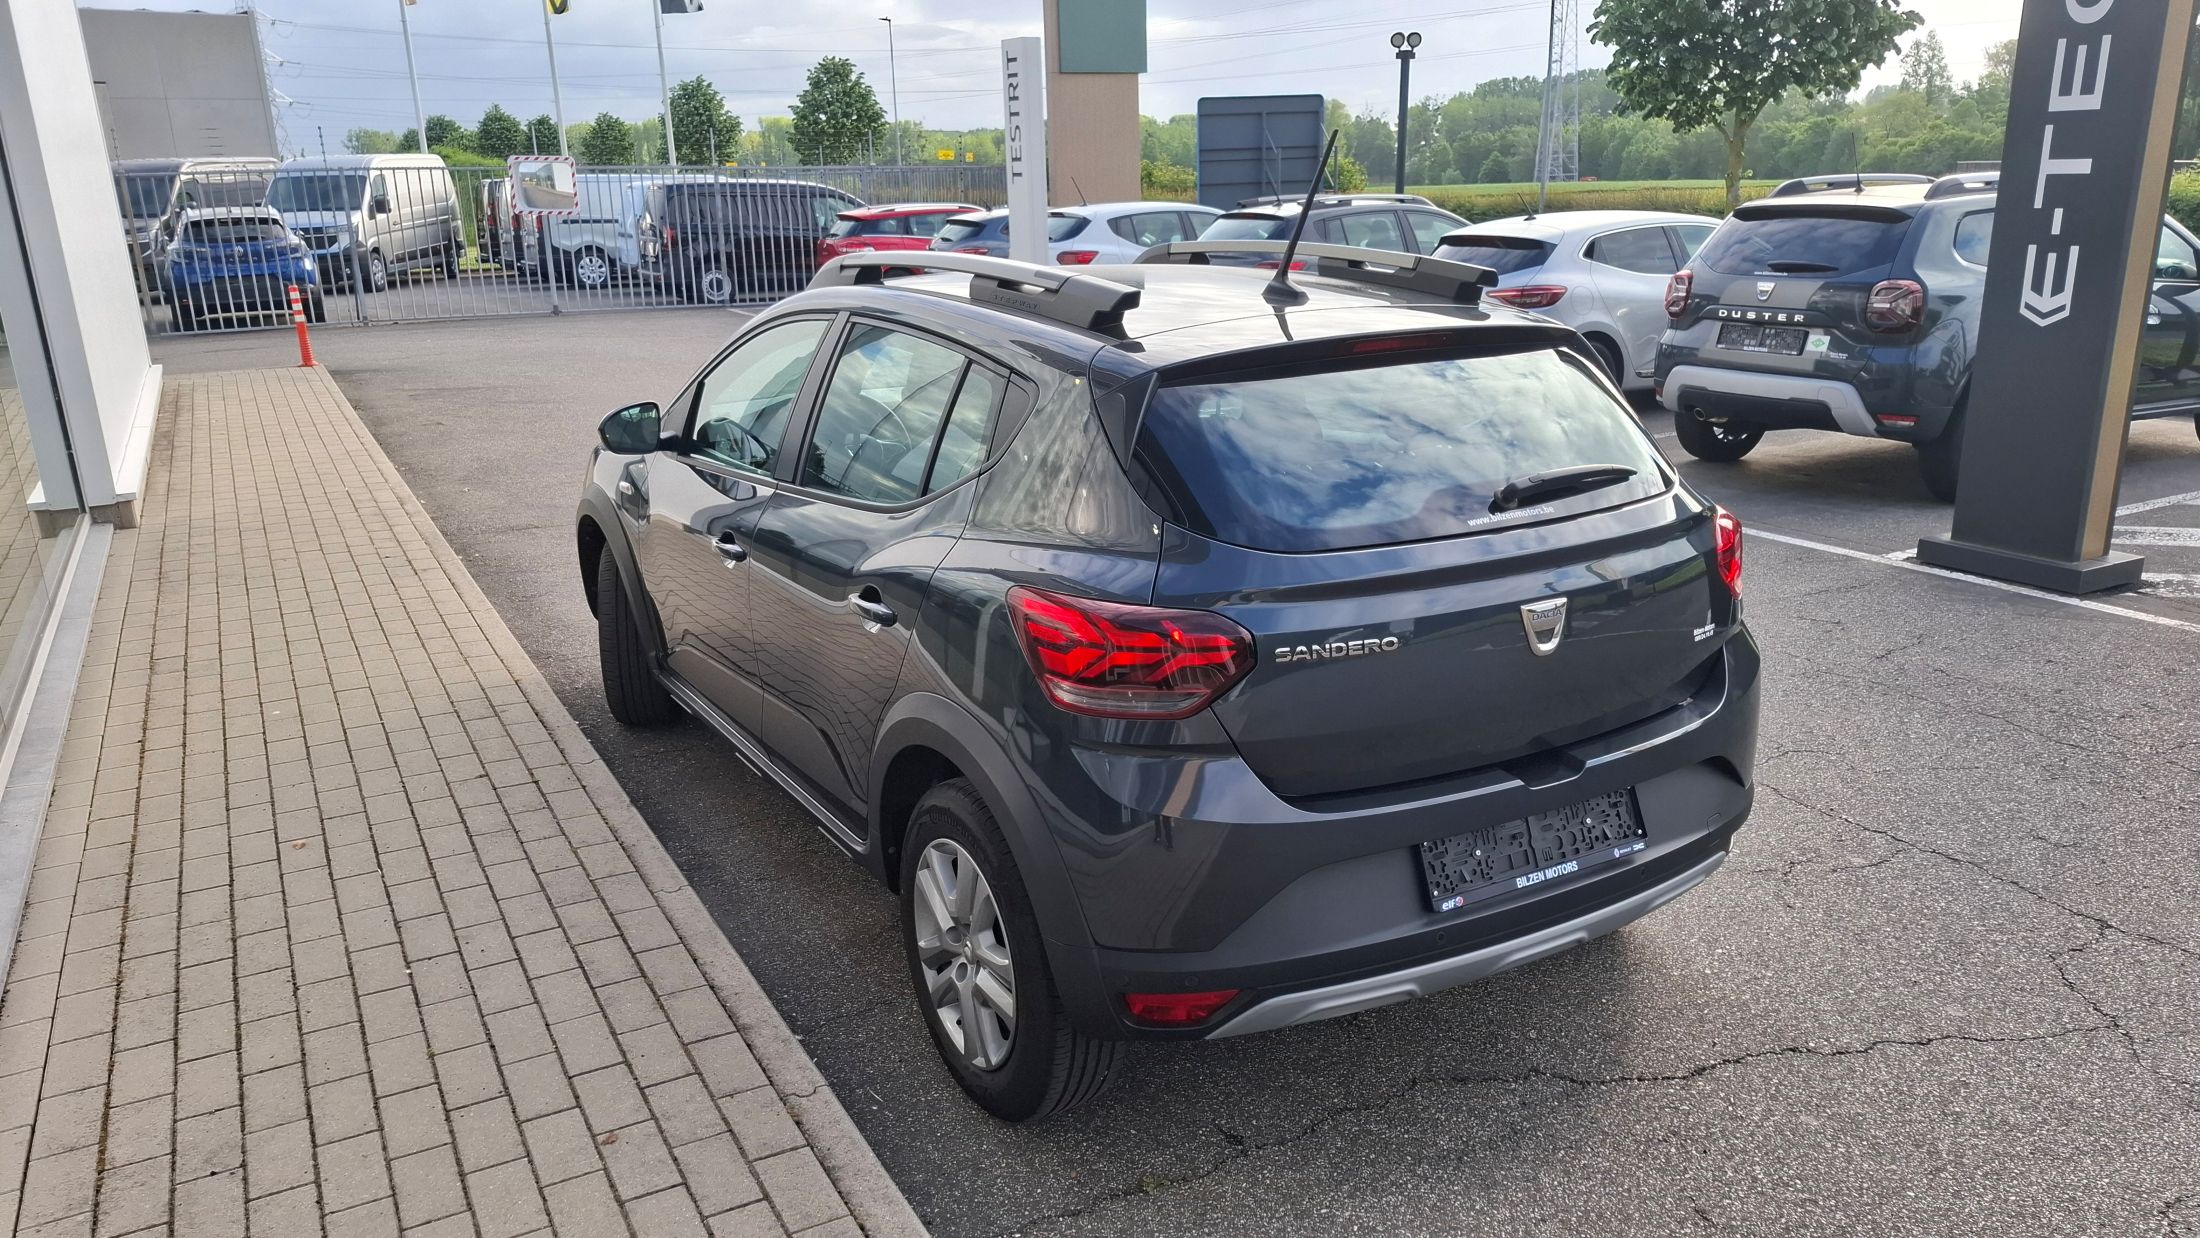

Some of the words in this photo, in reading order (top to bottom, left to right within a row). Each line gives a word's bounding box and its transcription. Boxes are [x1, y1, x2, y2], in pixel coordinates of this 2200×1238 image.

[1006, 50, 1023, 185] TESTRIT
[1718, 308, 1805, 322] DUSTER
[1467, 505, 1555, 526] www.bilzenmotors.be
[1531, 608, 1563, 622] DACIA
[1275, 635, 1399, 663] SANDERO
[1516, 871, 1546, 889] BILZEN
[1545, 860, 1579, 879] MOTORS
